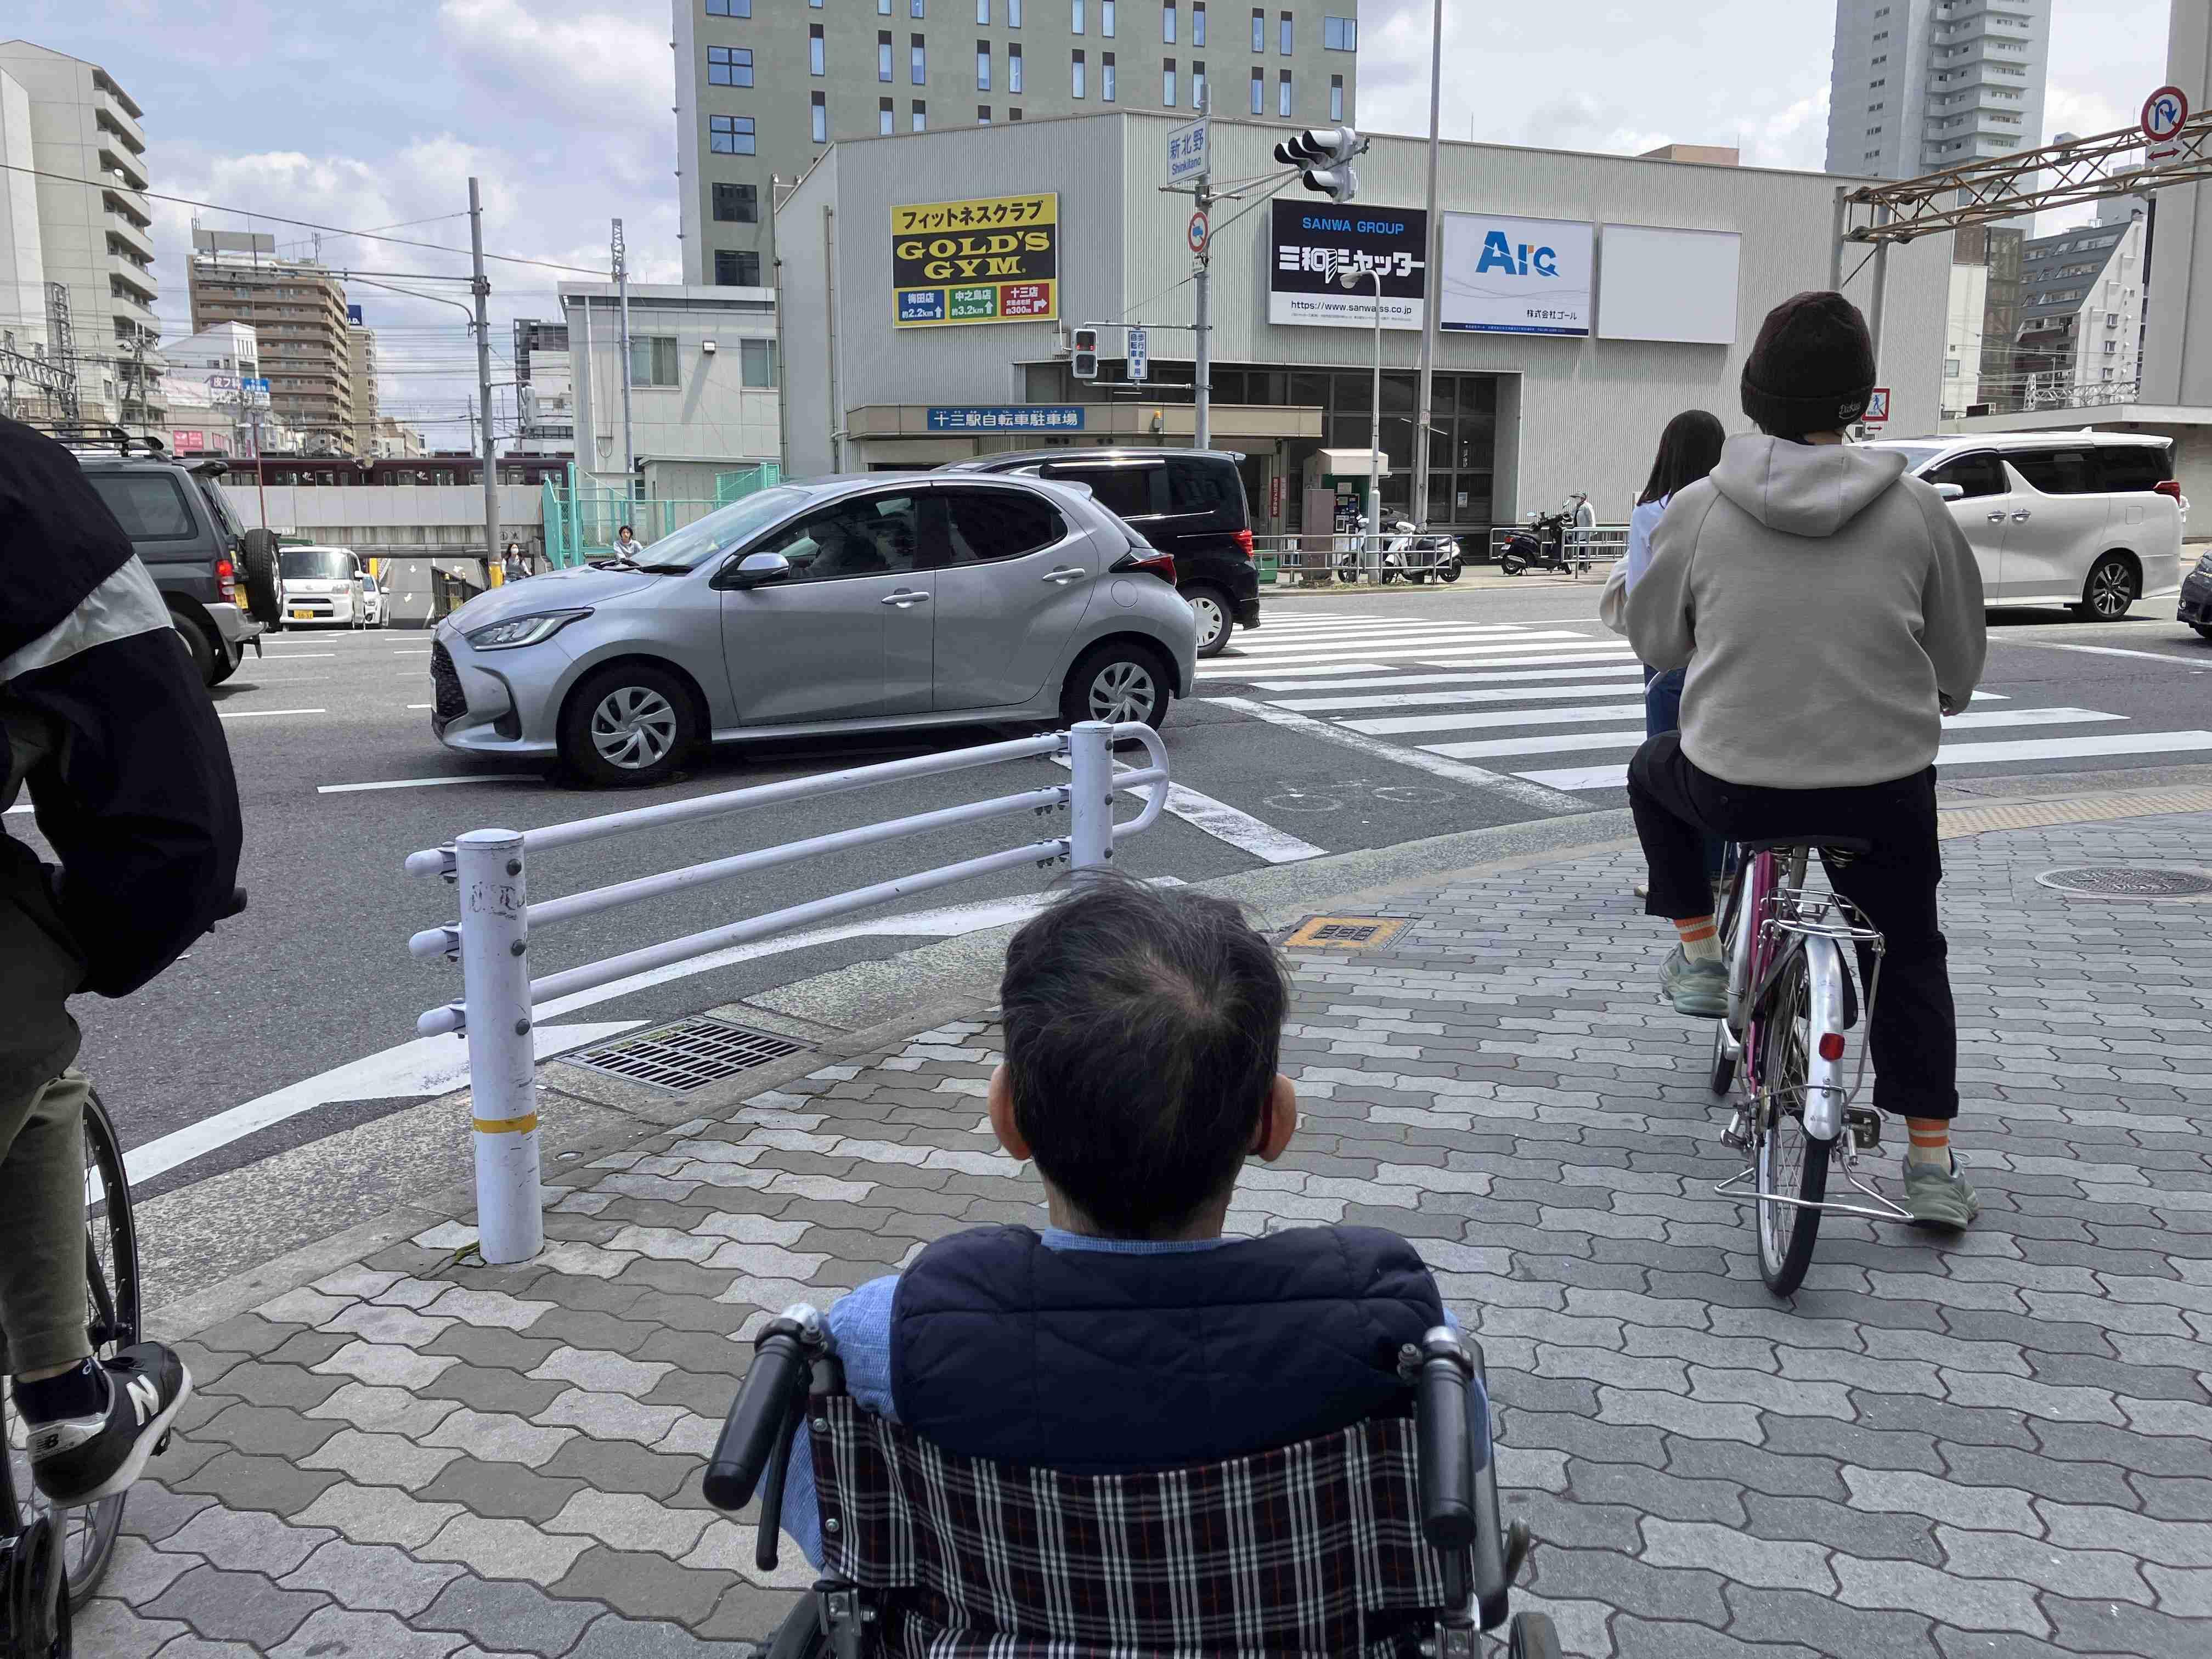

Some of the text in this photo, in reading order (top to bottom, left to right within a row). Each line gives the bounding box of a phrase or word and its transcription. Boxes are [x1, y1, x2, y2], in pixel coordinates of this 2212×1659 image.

[1170, 127, 1204, 159] 新北野
[1172, 157, 1201, 175] Shinkitano
[902, 200, 1044, 229] フィットネスクラブ
[1302, 216, 1404, 235] SANWA GROUP
[896, 231, 1050, 260] GOLD'S
[1475, 230, 1560, 277] Arc
[1279, 245, 1425, 284] 三和シャッター
[908, 292, 935, 304] 梅田店
[955, 289, 992, 302] 中之島店
[1011, 286, 1039, 298] 十三店
[1291, 300, 1412, 315] https://www.sanwass.co.jp
[1527, 309, 1577, 320] 株式会社ゴール
[934, 413, 1078, 426] 十三駅自転車駐車場
[126, 1374, 160, 1426] N
